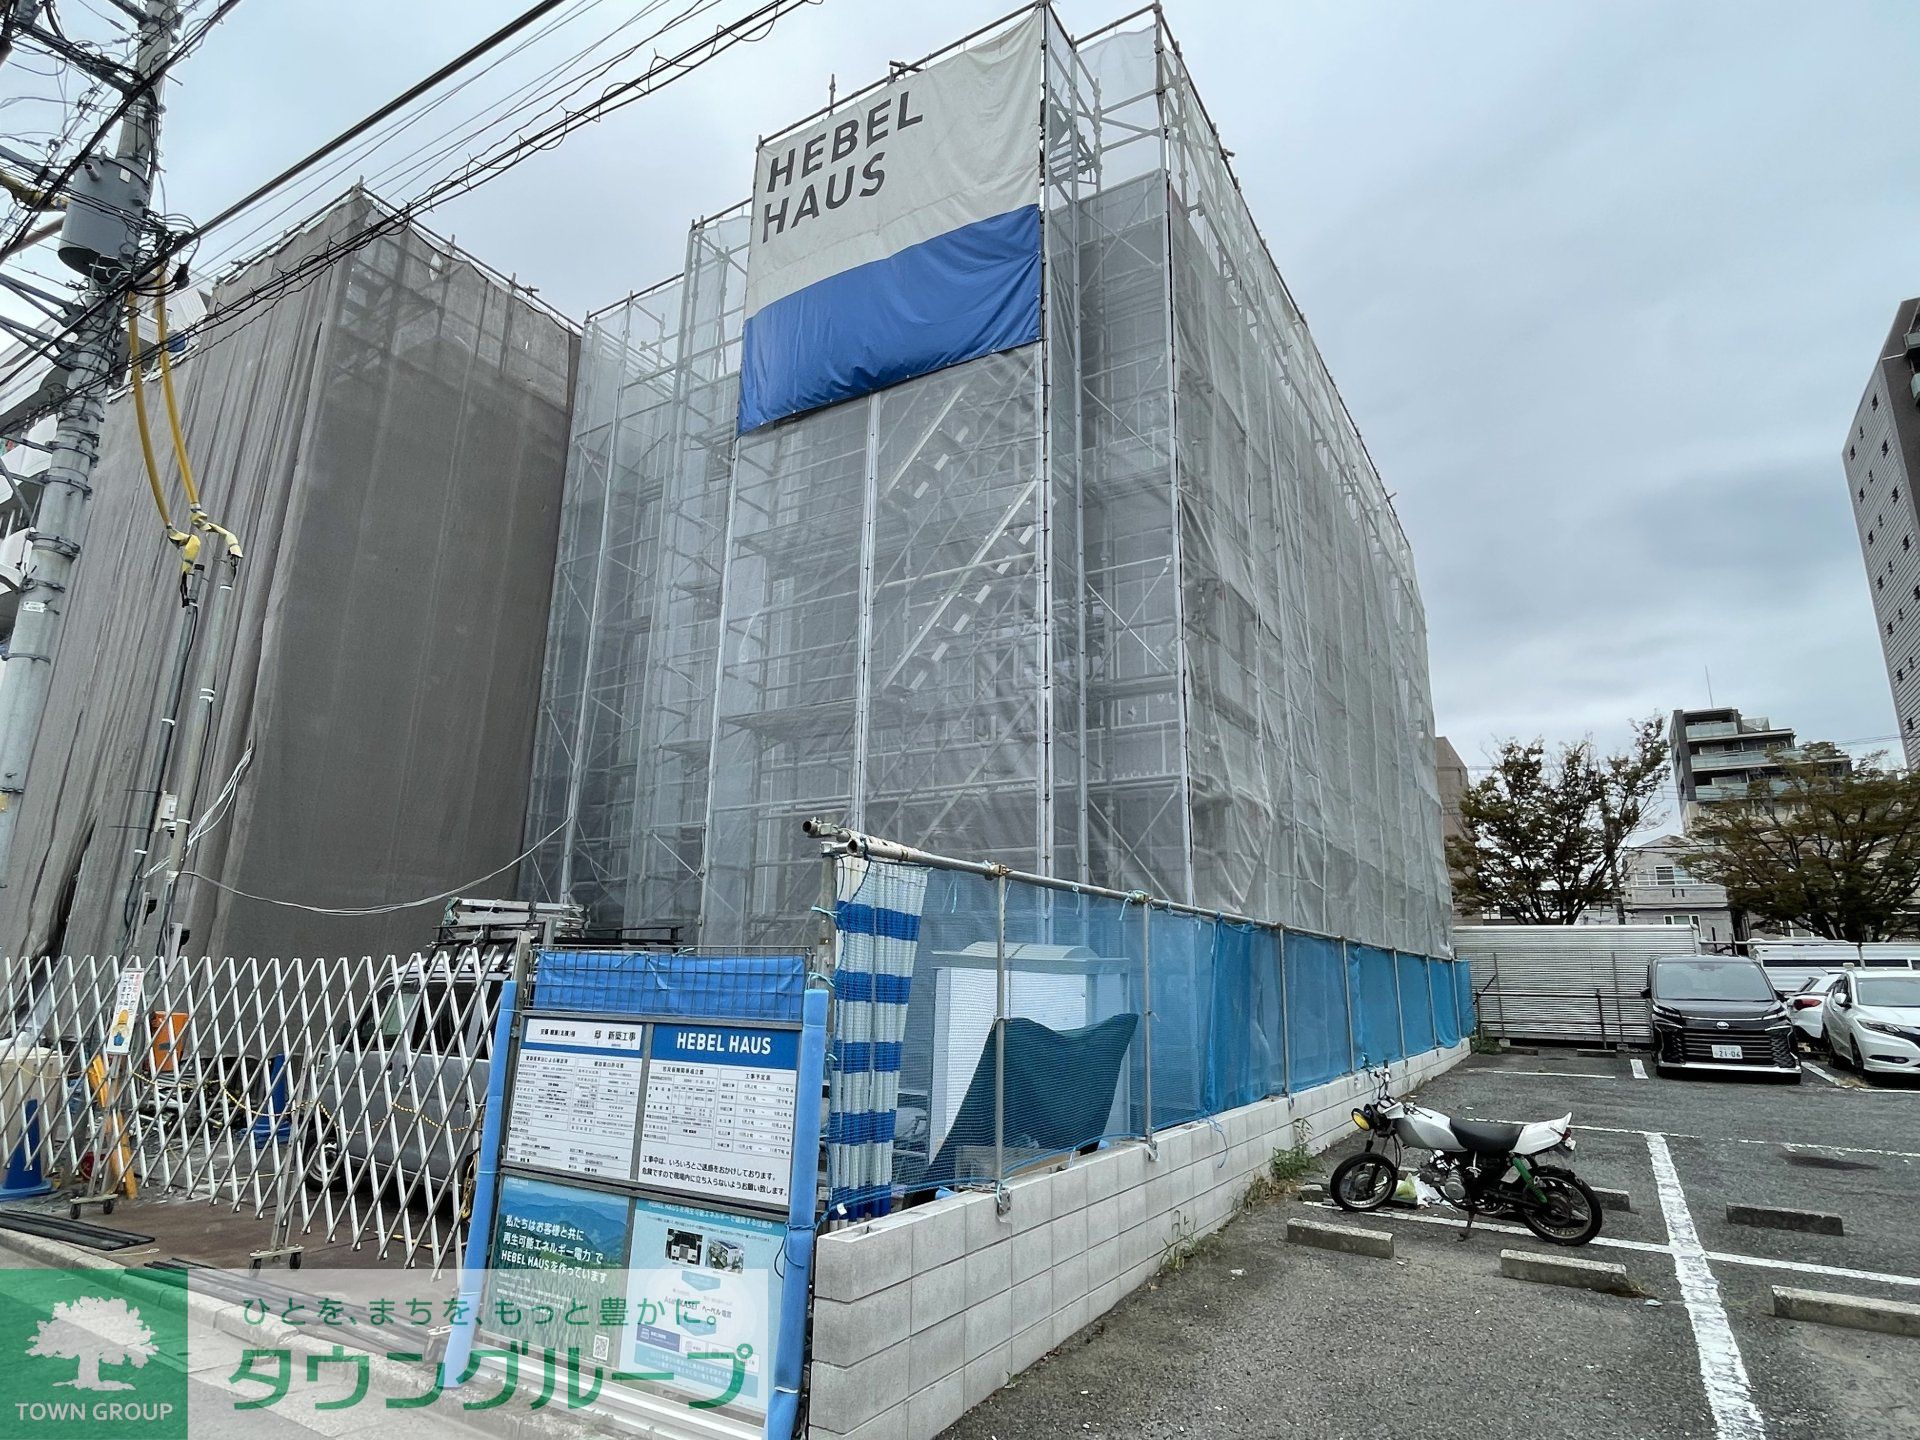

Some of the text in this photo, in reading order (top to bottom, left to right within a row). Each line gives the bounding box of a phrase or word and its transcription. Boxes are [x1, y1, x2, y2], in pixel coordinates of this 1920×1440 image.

[767, 91, 923, 193] HEBEL
[762, 151, 886, 243] HAUS
[676, 1032, 771, 1055] HEBEL HAUS
[506, 1214, 585, 1241] 私たちはお客様と共に
[501, 1250, 526, 1266] HEBEL
